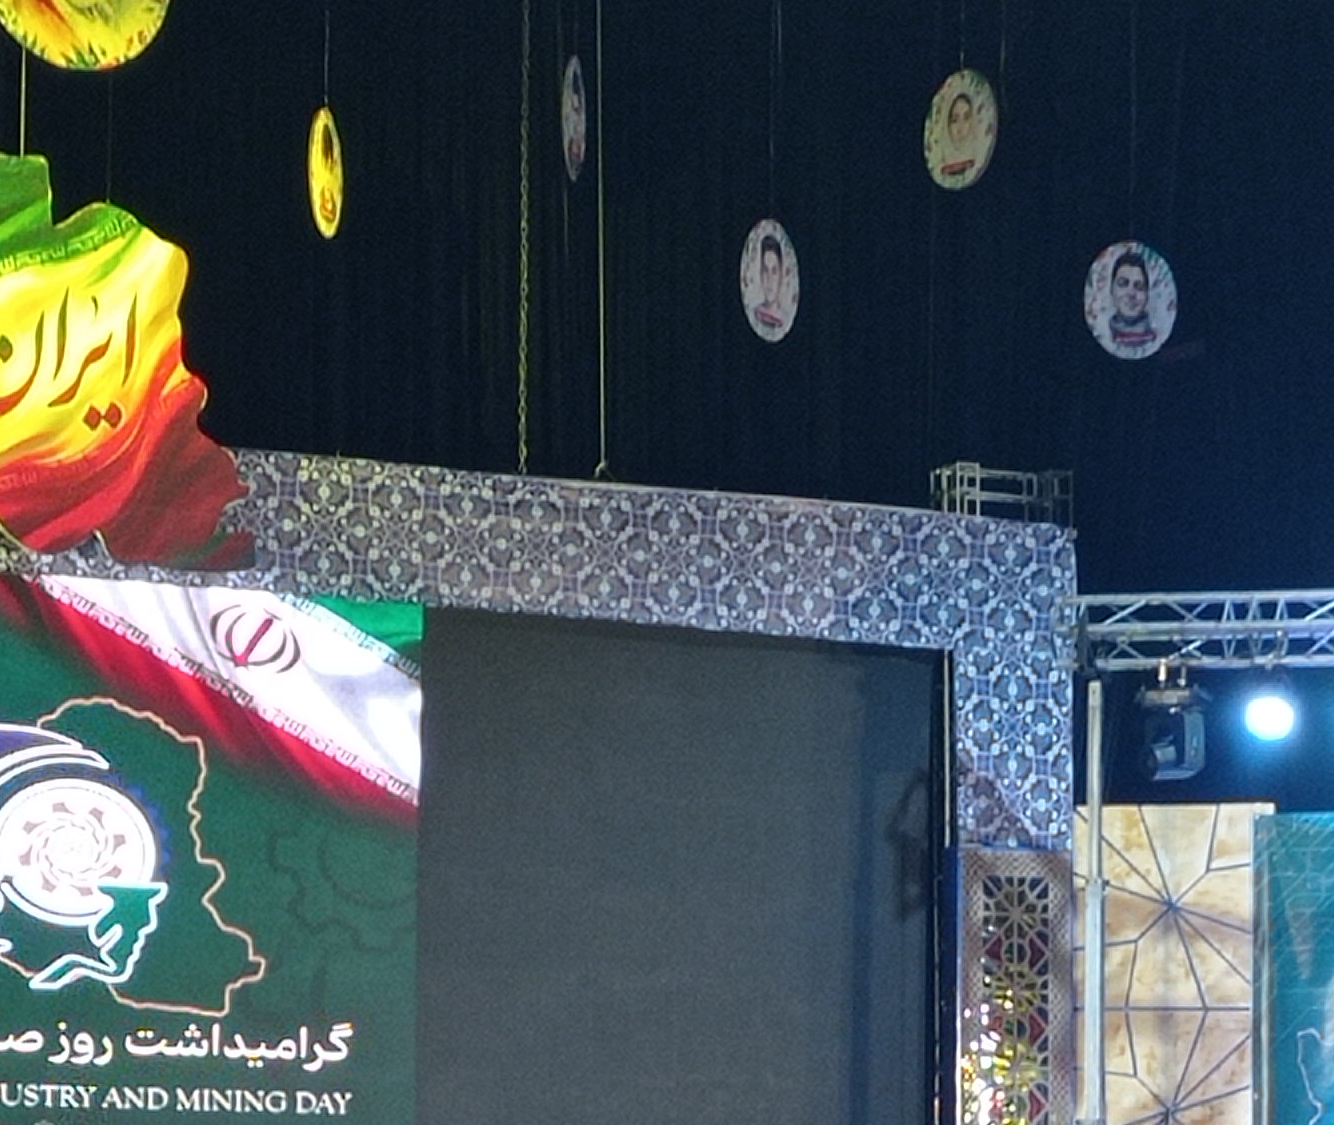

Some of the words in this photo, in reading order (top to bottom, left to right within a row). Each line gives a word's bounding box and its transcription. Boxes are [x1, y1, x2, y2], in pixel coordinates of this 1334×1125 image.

[48, 1021, 114, 1066] روز
[124, 1021, 354, 1072] گرامیداشت
[102, 1085, 169, 1111] AND
[175, 1086, 288, 1114] MINING
[295, 1090, 353, 1116] DAY
